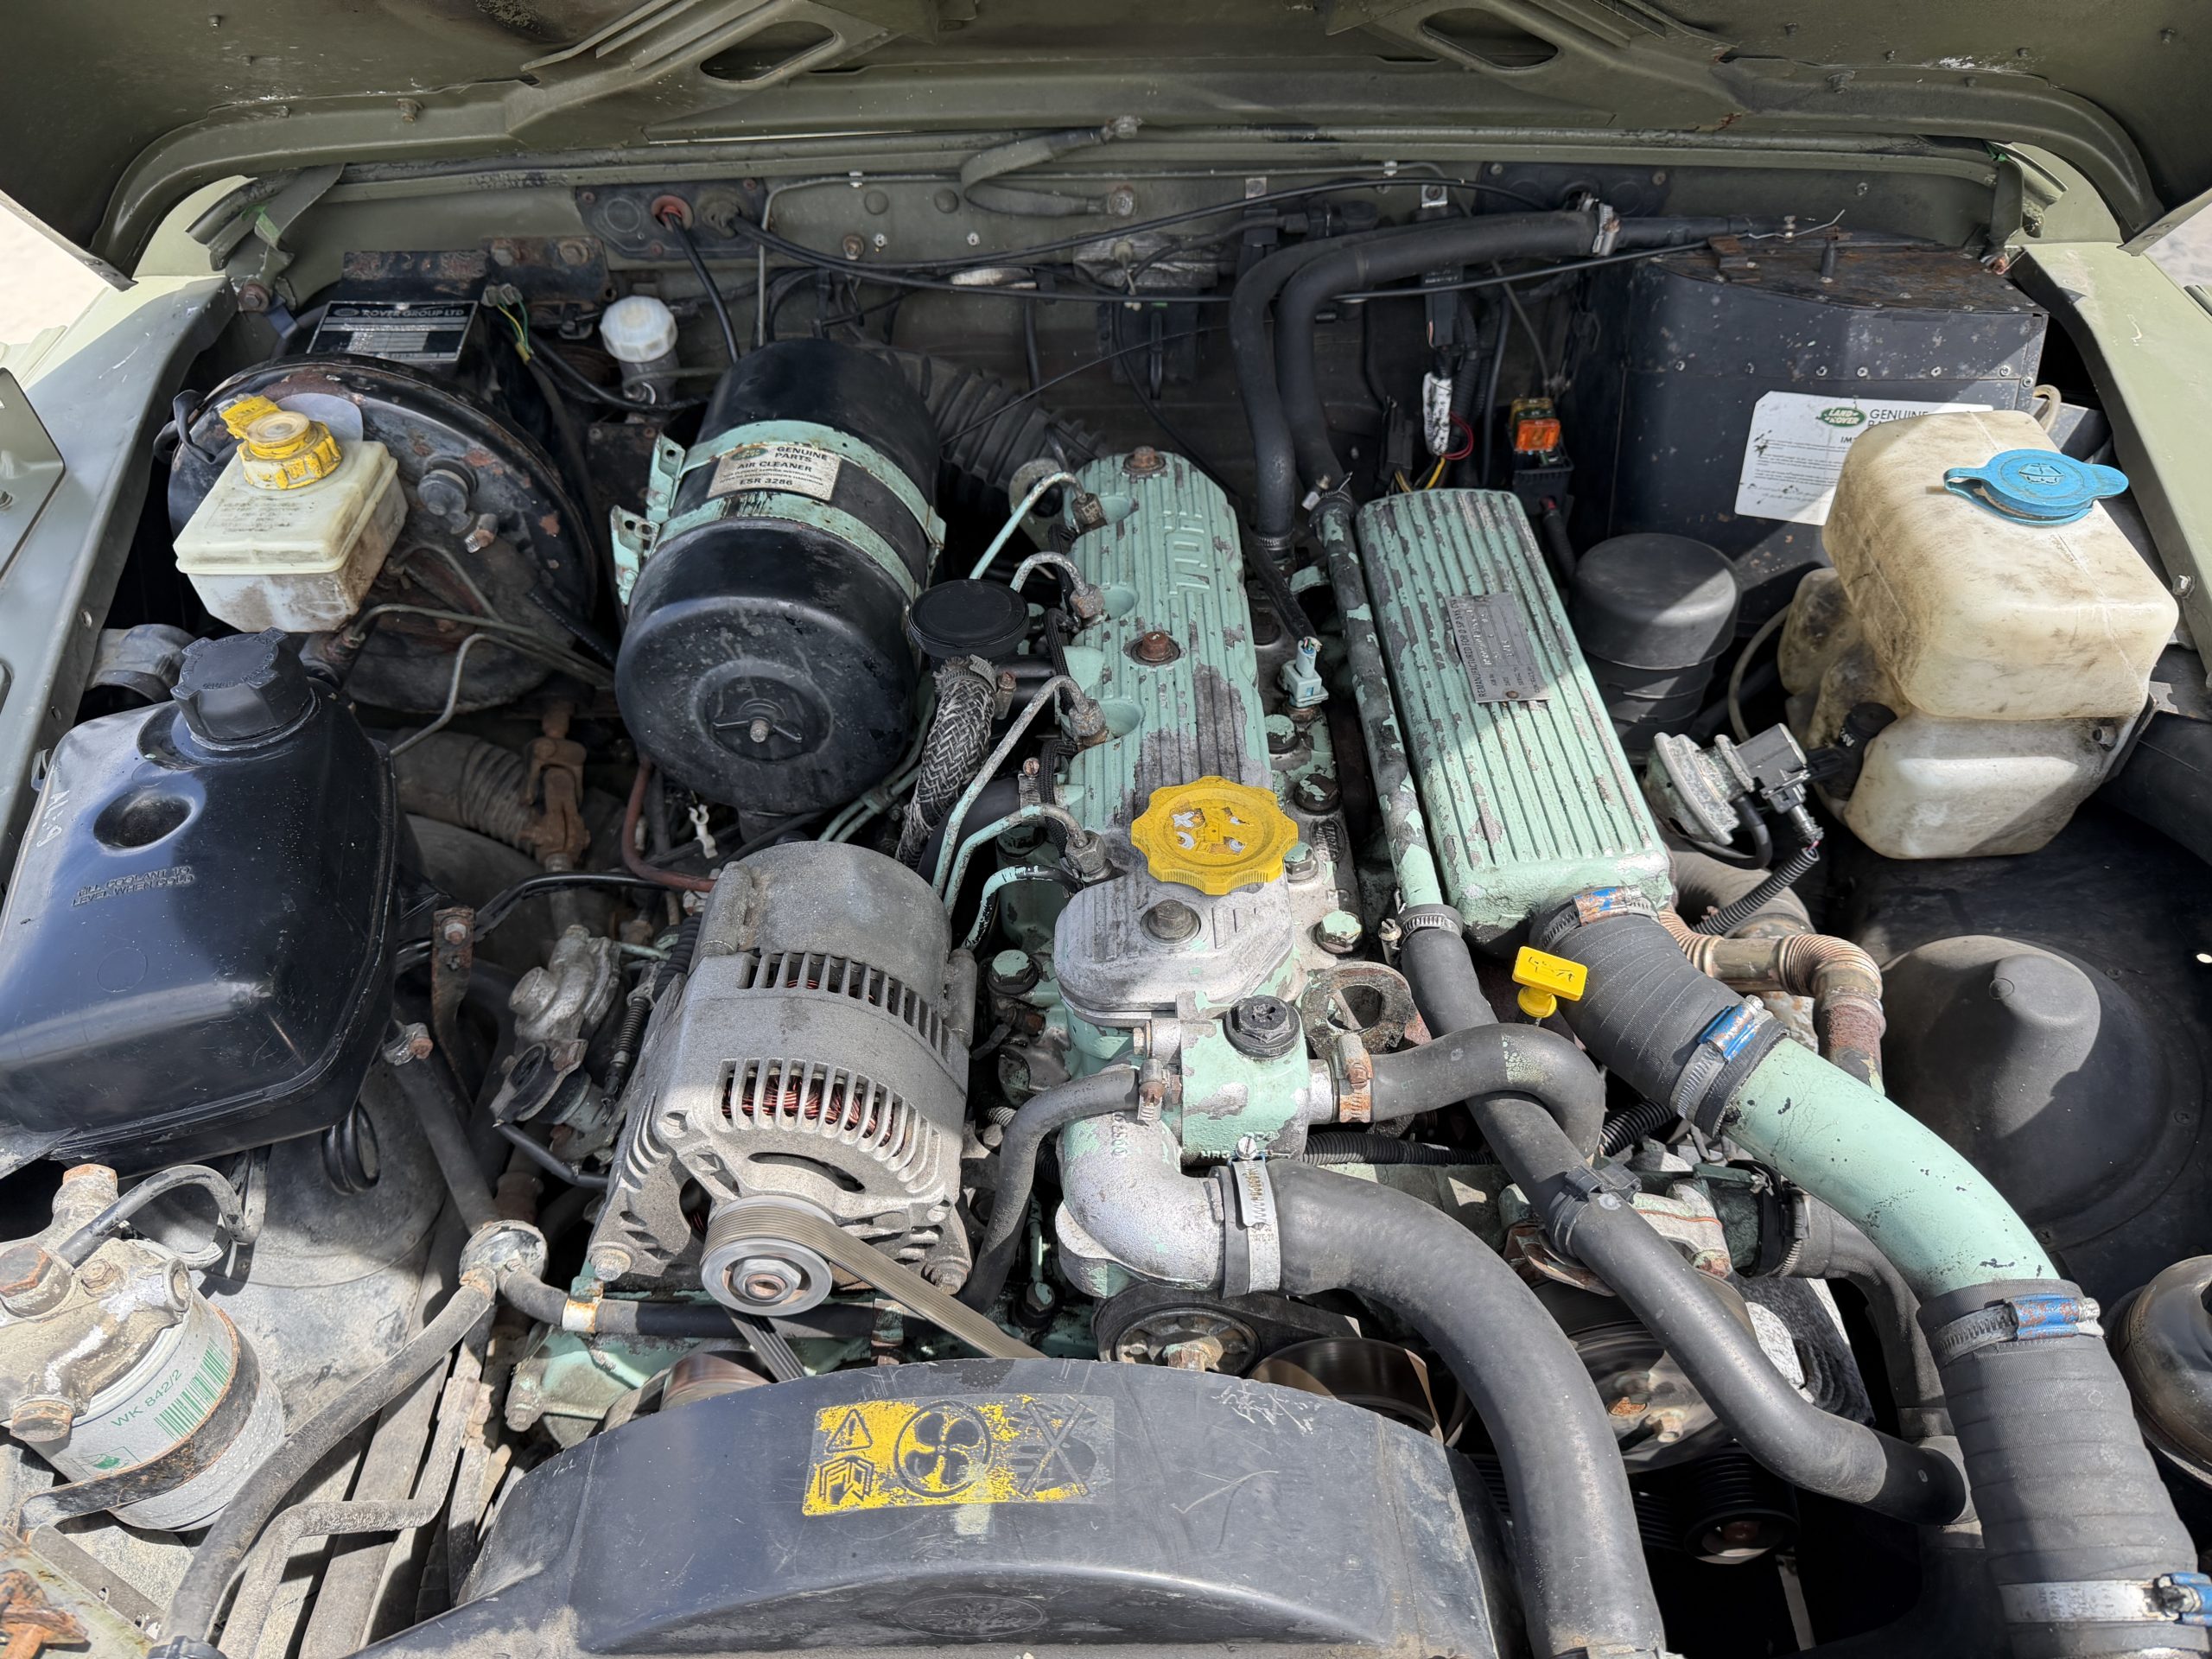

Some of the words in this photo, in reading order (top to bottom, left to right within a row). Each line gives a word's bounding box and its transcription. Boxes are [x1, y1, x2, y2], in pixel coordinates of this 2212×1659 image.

[1828, 408, 1853, 416] LAND
[1829, 416, 1860, 425] ROVER
[775, 453, 812, 462] PARTS
[777, 446, 828, 461] GENUINE
[737, 461, 756, 470] AIR
[760, 461, 812, 473] CLEANER
[1459, 635, 1471, 645] FOR
[1463, 646, 1487, 696] REMANUFACTURED
[78, 885, 101, 897] FILL
[106, 868, 167, 888] COOLANT
[173, 865, 192, 876] TO
[72, 891, 111, 906] LEVEL
[114, 881, 153, 896] WHEN
[156, 874, 195, 887] COLD
[111, 1406, 144, 1427] WK
[145, 1369, 183, 1408] 842/2
